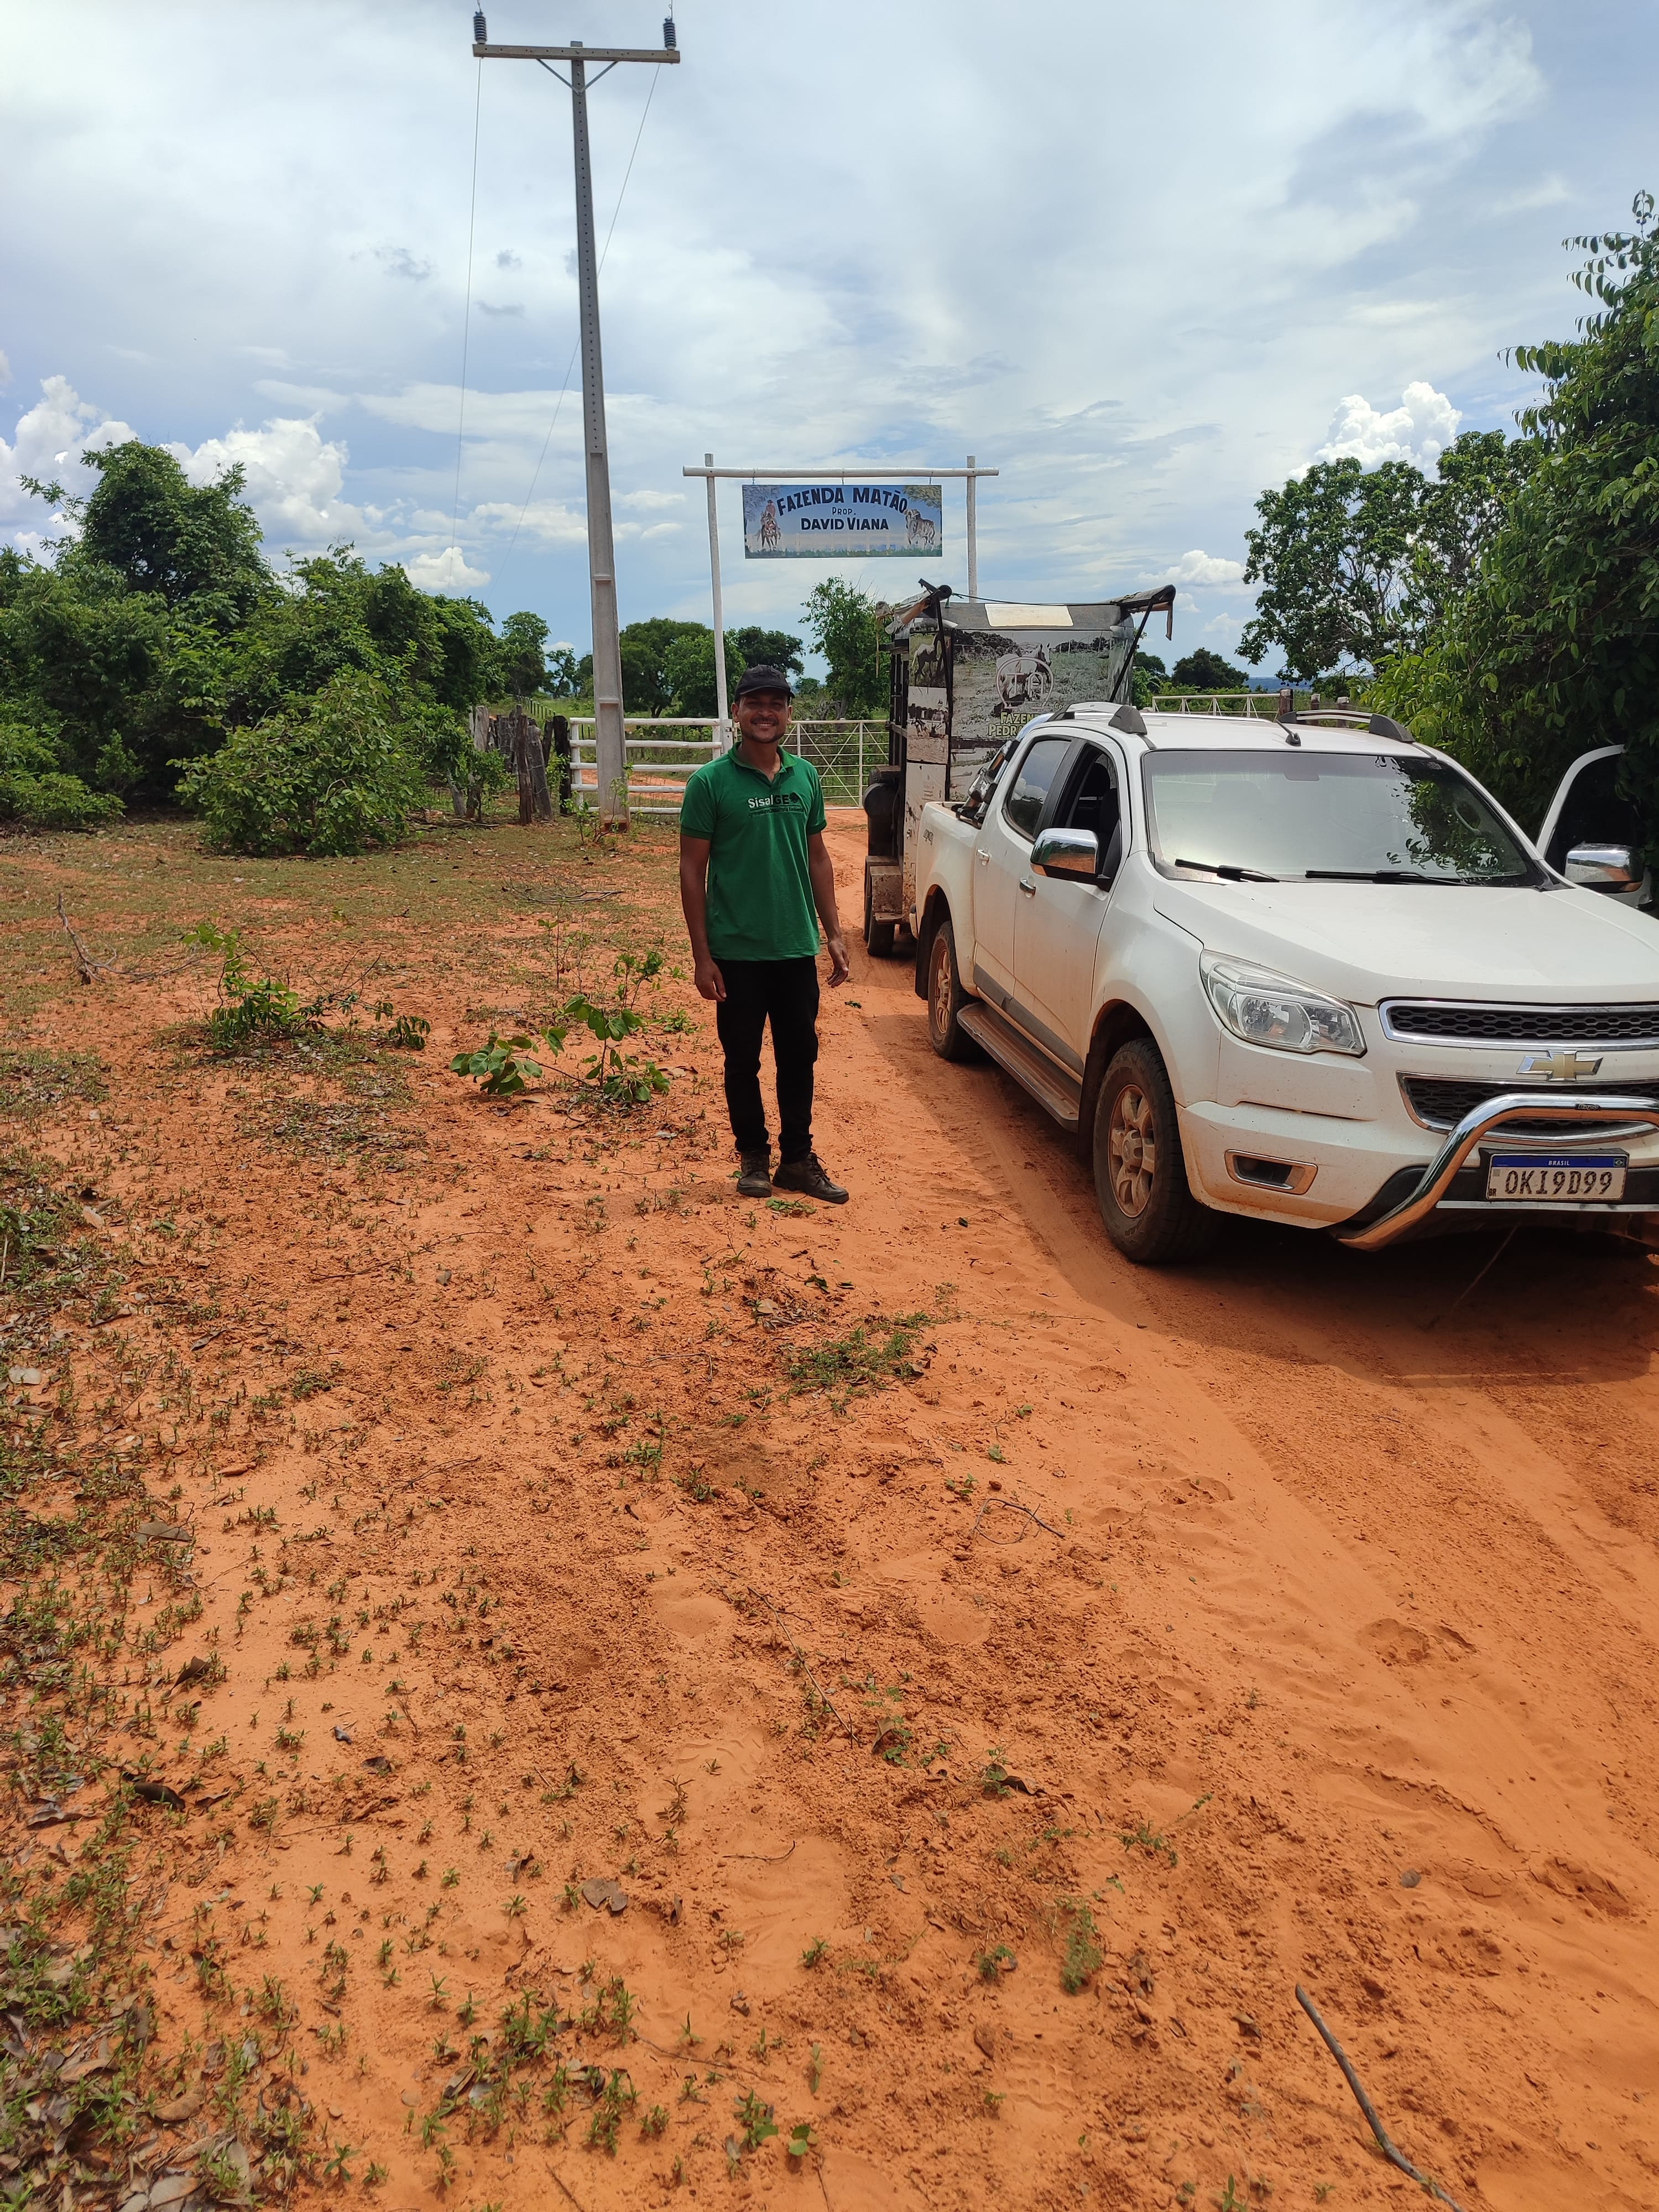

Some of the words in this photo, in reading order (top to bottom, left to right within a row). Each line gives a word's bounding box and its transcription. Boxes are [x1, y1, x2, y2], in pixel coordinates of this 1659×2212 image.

[776, 488, 844, 517] FAZENDA
[853, 487, 907, 513] MATÃO
[801, 518, 844, 530] DAVID
[847, 517, 889, 530] VIANA
[1000, 712, 1039, 724] FAZEN
[1504, 1170, 1613, 1194] OKI9D99
[1489, 1188, 1496, 1197] BR
